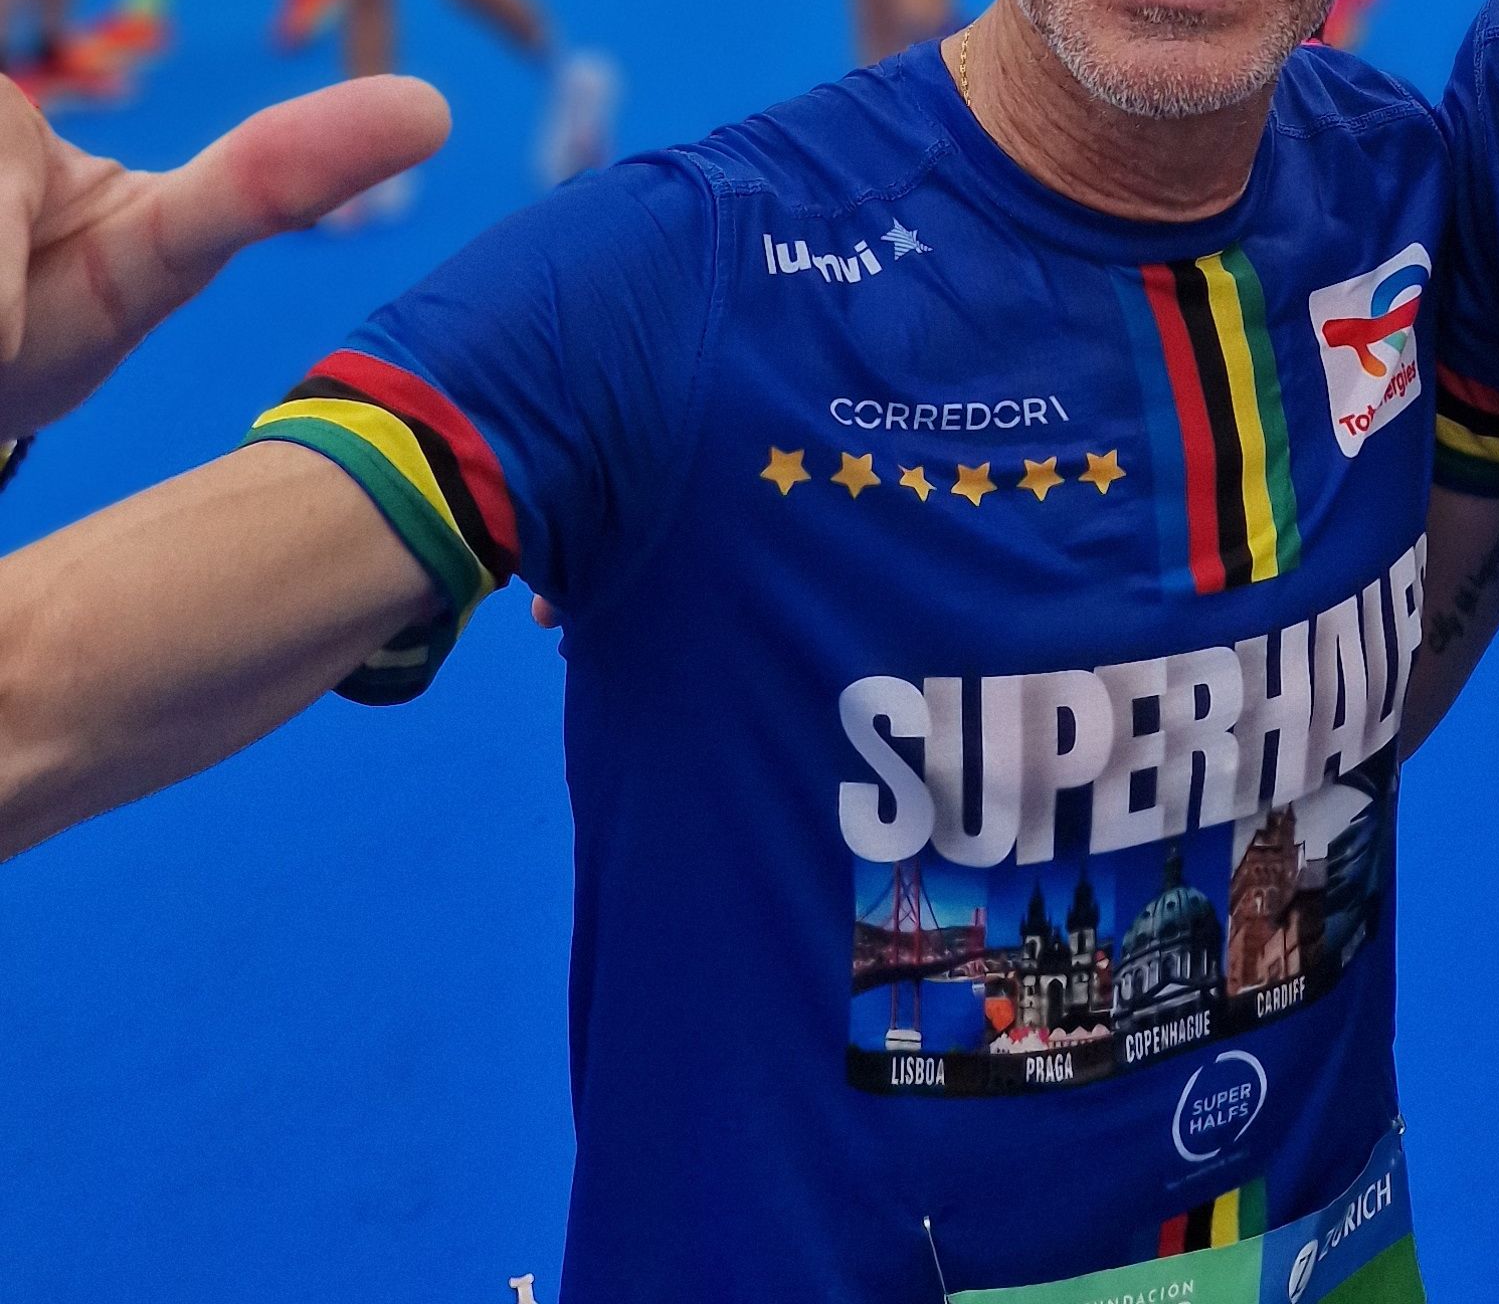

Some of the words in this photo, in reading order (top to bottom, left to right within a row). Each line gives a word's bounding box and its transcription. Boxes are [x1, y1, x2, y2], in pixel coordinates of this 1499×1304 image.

[1257, 976, 1306, 1018] CARDIFF
[1125, 1010, 1211, 1063] COPENHAGUE
[891, 1057, 945, 1086] LISBOA
[1026, 1052, 1074, 1082] PRAGA
[1192, 1083, 1252, 1116] SUPER
[1190, 1103, 1249, 1134] HALFS
[1318, 1173, 1392, 1262] ZURICH
